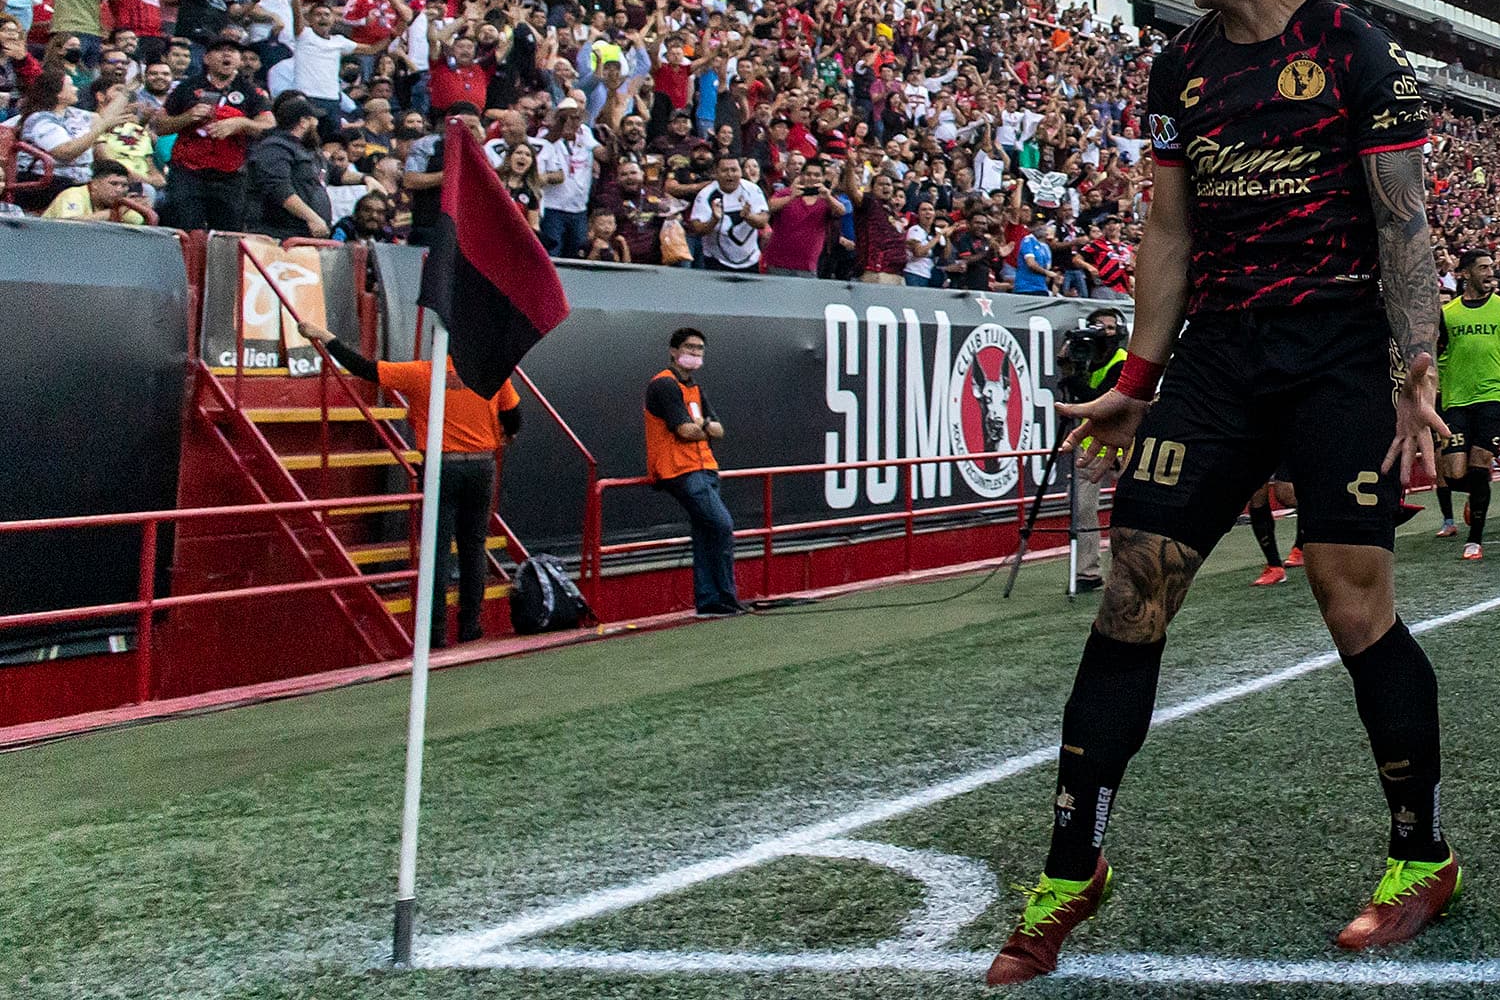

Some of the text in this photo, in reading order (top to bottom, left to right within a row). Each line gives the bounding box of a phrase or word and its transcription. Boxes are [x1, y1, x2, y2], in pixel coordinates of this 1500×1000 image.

[1452, 324, 1498, 337] CHARLY
[1451, 433, 1465, 447] 35
[1133, 437, 1186, 486] 10
[1092, 786, 1113, 848] WONDER
